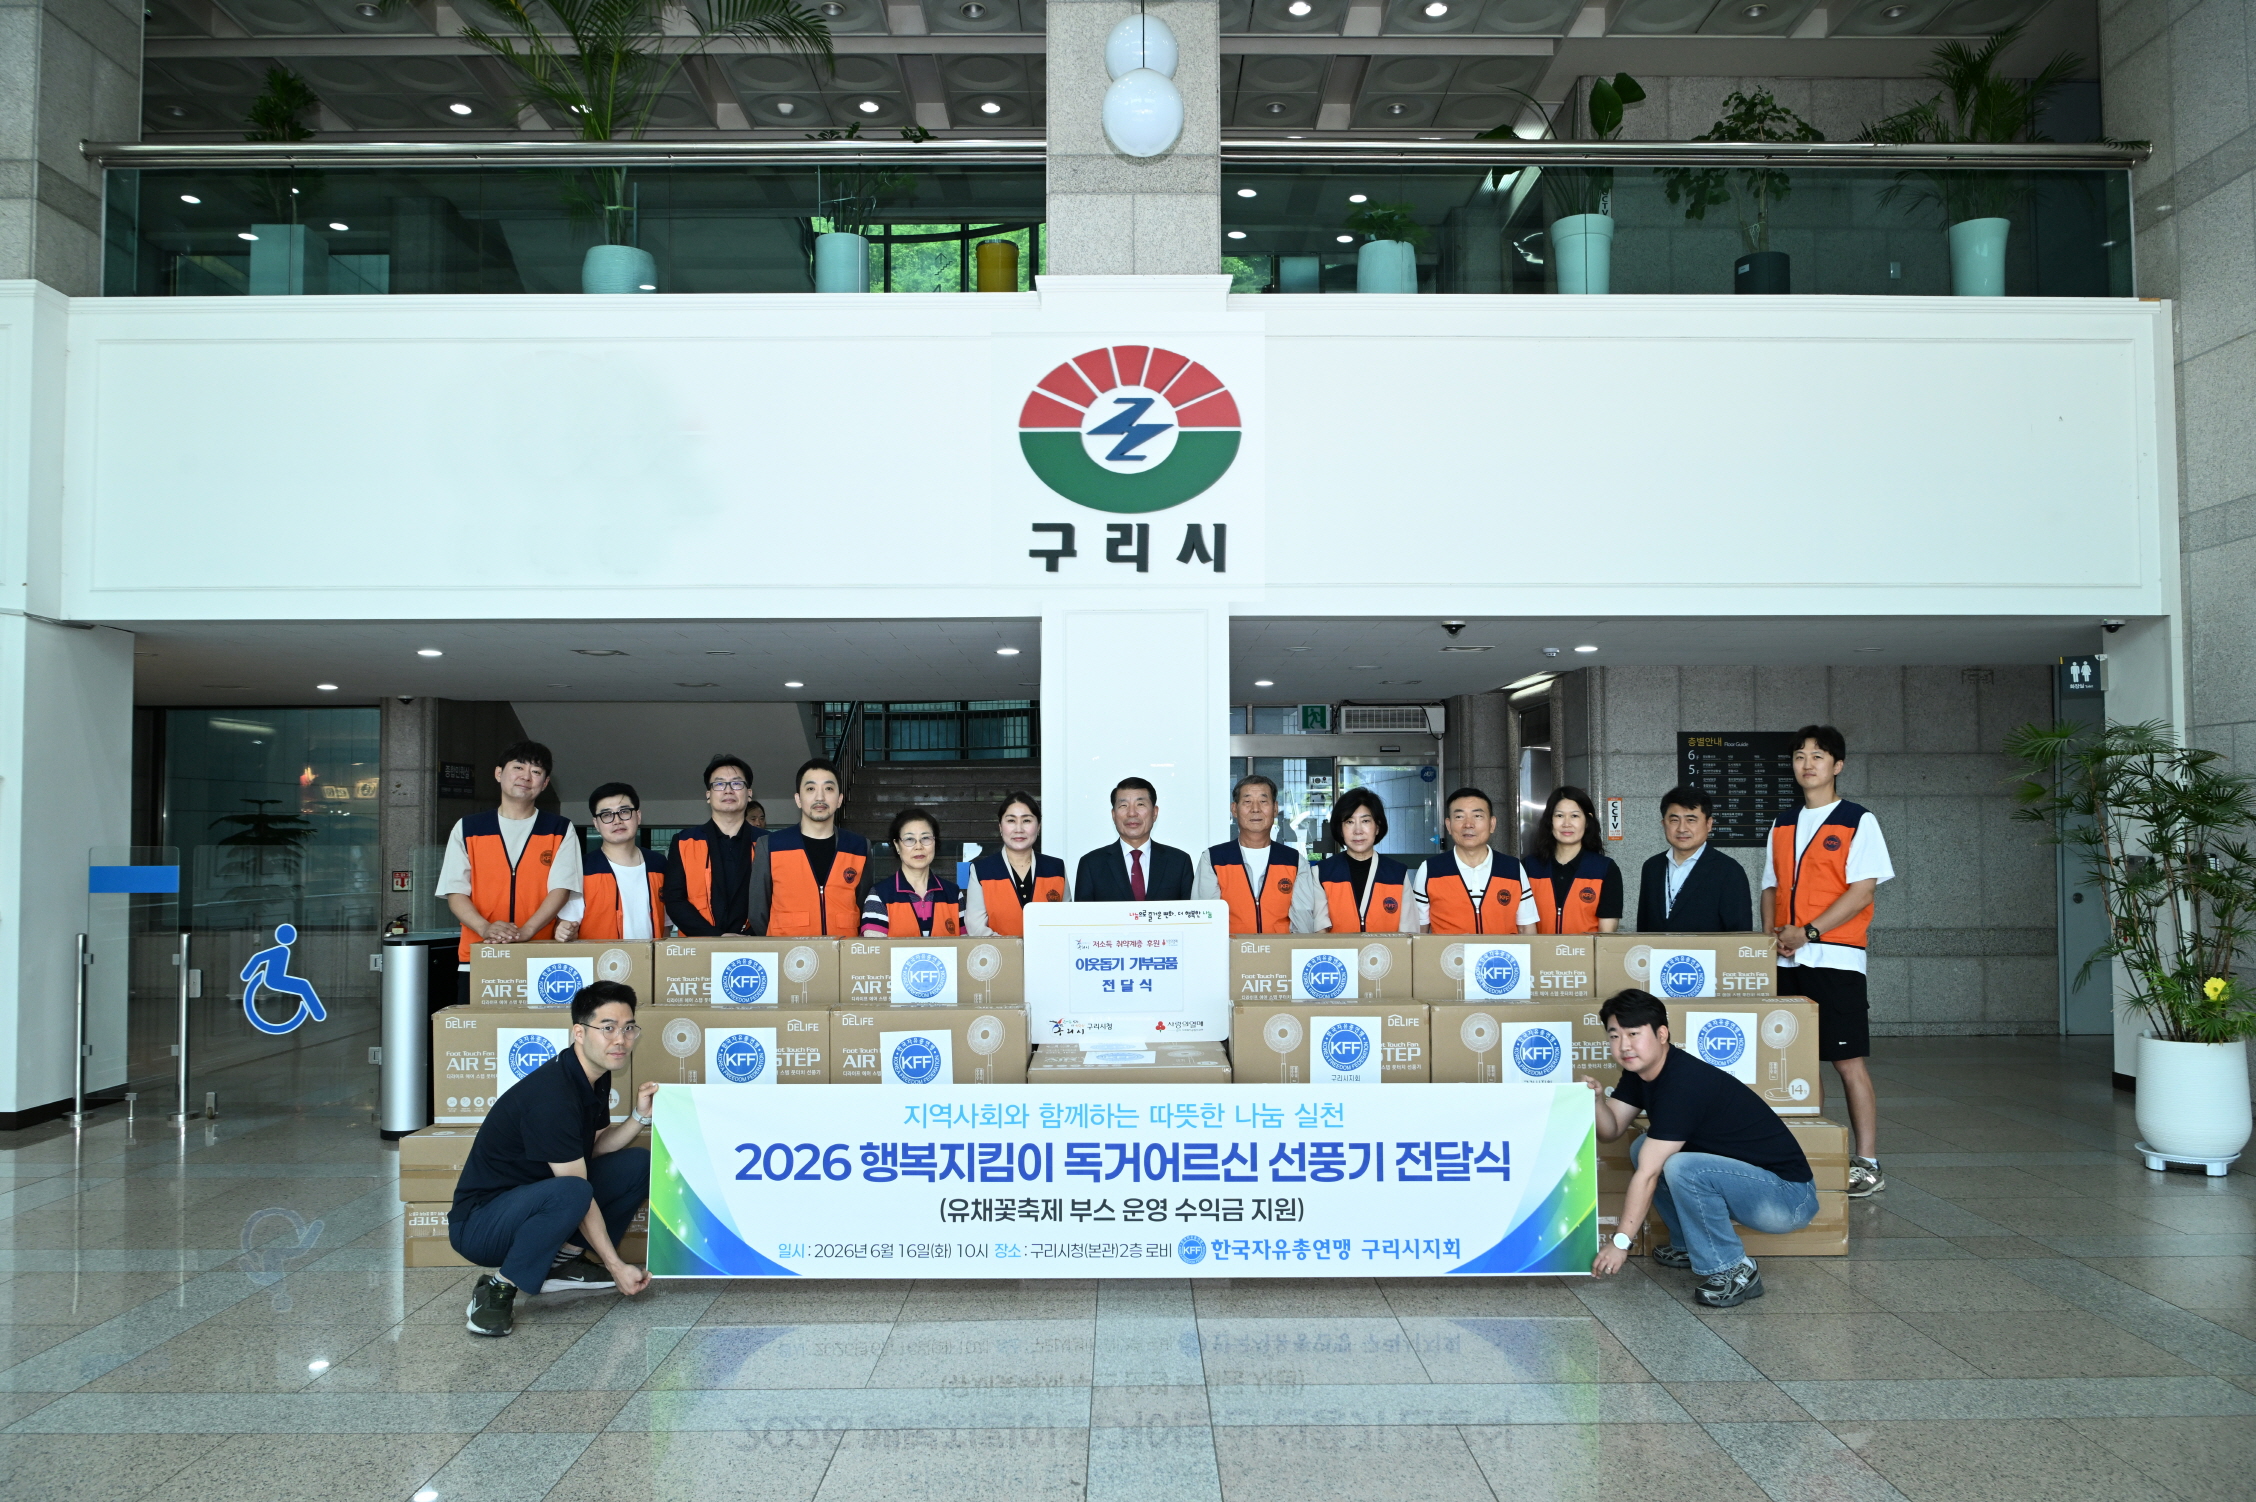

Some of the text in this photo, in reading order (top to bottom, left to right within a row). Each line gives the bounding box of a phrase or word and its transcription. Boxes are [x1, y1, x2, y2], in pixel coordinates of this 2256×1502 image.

[1029, 522, 1227, 572] 구리시
[1688, 737, 1722, 747] 층별안내
[851, 943, 880, 954] DELIFE
[1093, 940, 1112, 948] 저소득
[1116, 940, 1143, 948] 취약계층
[1147, 940, 1160, 948] 후원
[1241, 942, 1270, 953] DELIFE
[1556, 944, 1585, 956] DELIFE
[481, 947, 511, 958] DELIFE
[666, 945, 696, 956] DELIFE
[1739, 946, 1768, 958] DELIFE
[1076, 957, 1178, 971] 이웃돕기 기부금품
[910, 971, 938, 983] KFF
[1311, 972, 1339, 984] KFF
[1483, 968, 1512, 979] KFF
[1668, 973, 1696, 984] KFF
[546, 981, 575, 993] KFF
[730, 976, 759, 988] KFF
[852, 981, 882, 994] AIR
[1242, 980, 1272, 992] AIR
[1540, 976, 1587, 988] STEP
[1723, 977, 1769, 989] STEP
[481, 984, 512, 998] AIR
[667, 983, 697, 995] AIR
[445, 1016, 477, 1029] DELIFE
[842, 1013, 874, 1025] DELIFE
[1168, 1020, 1203, 1028] 사랑의열매
[1388, 1014, 1419, 1026] DELIFE
[787, 1019, 819, 1032] DELIFE
[1331, 1042, 1361, 1054] KFF
[1706, 1038, 1736, 1050] KFF
[726, 1053, 756, 1066] KFF
[776, 1052, 821, 1067] STEP
[1381, 1048, 1420, 1061] TEP
[1522, 1047, 1552, 1060] KFF
[446, 1058, 478, 1071] AIR
[843, 1055, 876, 1068] AIR
[901, 1056, 932, 1069] KFF
[904, 1103, 1344, 1129] 지역사회와 함께하는 따뜻한 나눔 실천
[735, 1141, 1511, 1183] 2026 행복지킴이 독거어르신 선풍기 전달식
[940, 1198, 1304, 1222] (유채꽃축제 부스 운영 수익금 지원)
[409, 1217, 438, 1226] STEP
[778, 1243, 805, 1258] 일시
[814, 1243, 867, 1258] 2026년
[870, 1243, 894, 1258] 6월
[898, 1243, 952, 1258] 16일(화)
[956, 1243, 988, 1258] 10시
[994, 1243, 1022, 1258] 장소
[1030, 1243, 1142, 1258] 구리시청(본관)2층
[1146, 1243, 1172, 1258] 로비
[1184, 1246, 1200, 1254] KFF
[1211, 1238, 1351, 1261] 한국자유총연맹
[1361, 1238, 1461, 1260] 구리시지회
